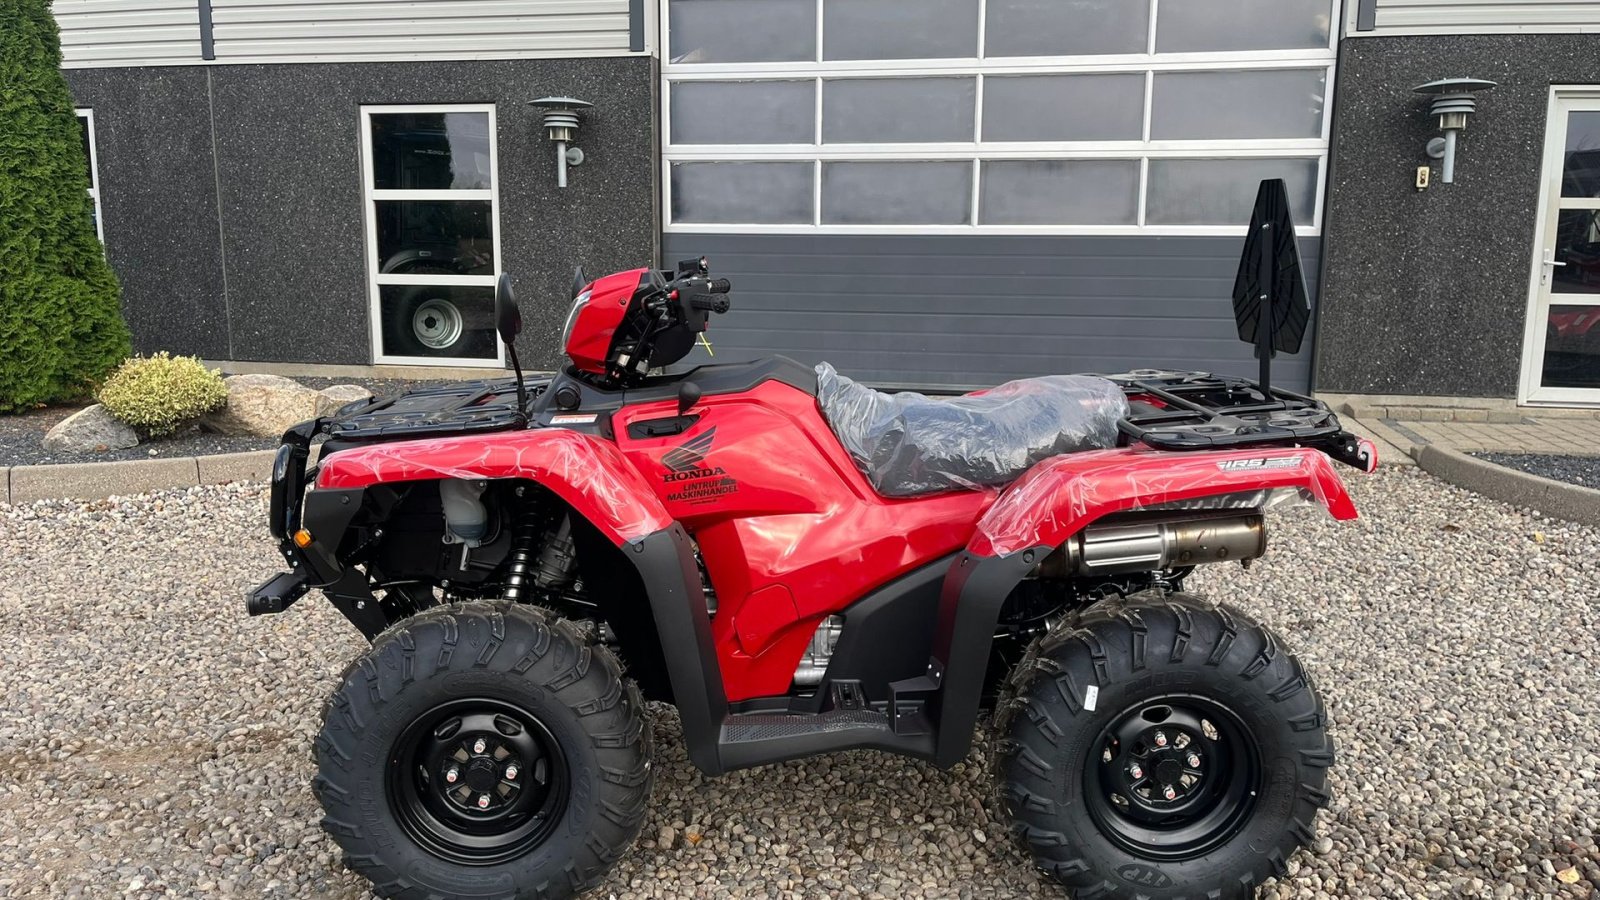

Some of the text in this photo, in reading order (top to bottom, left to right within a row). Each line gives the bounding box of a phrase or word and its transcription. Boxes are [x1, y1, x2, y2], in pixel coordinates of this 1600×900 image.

[1225, 459, 1264, 469] IRS
[664, 467, 726, 482] HONDA
[684, 480, 721, 491] LINTRUP
[667, 486, 738, 501] MASKINHANDEL
